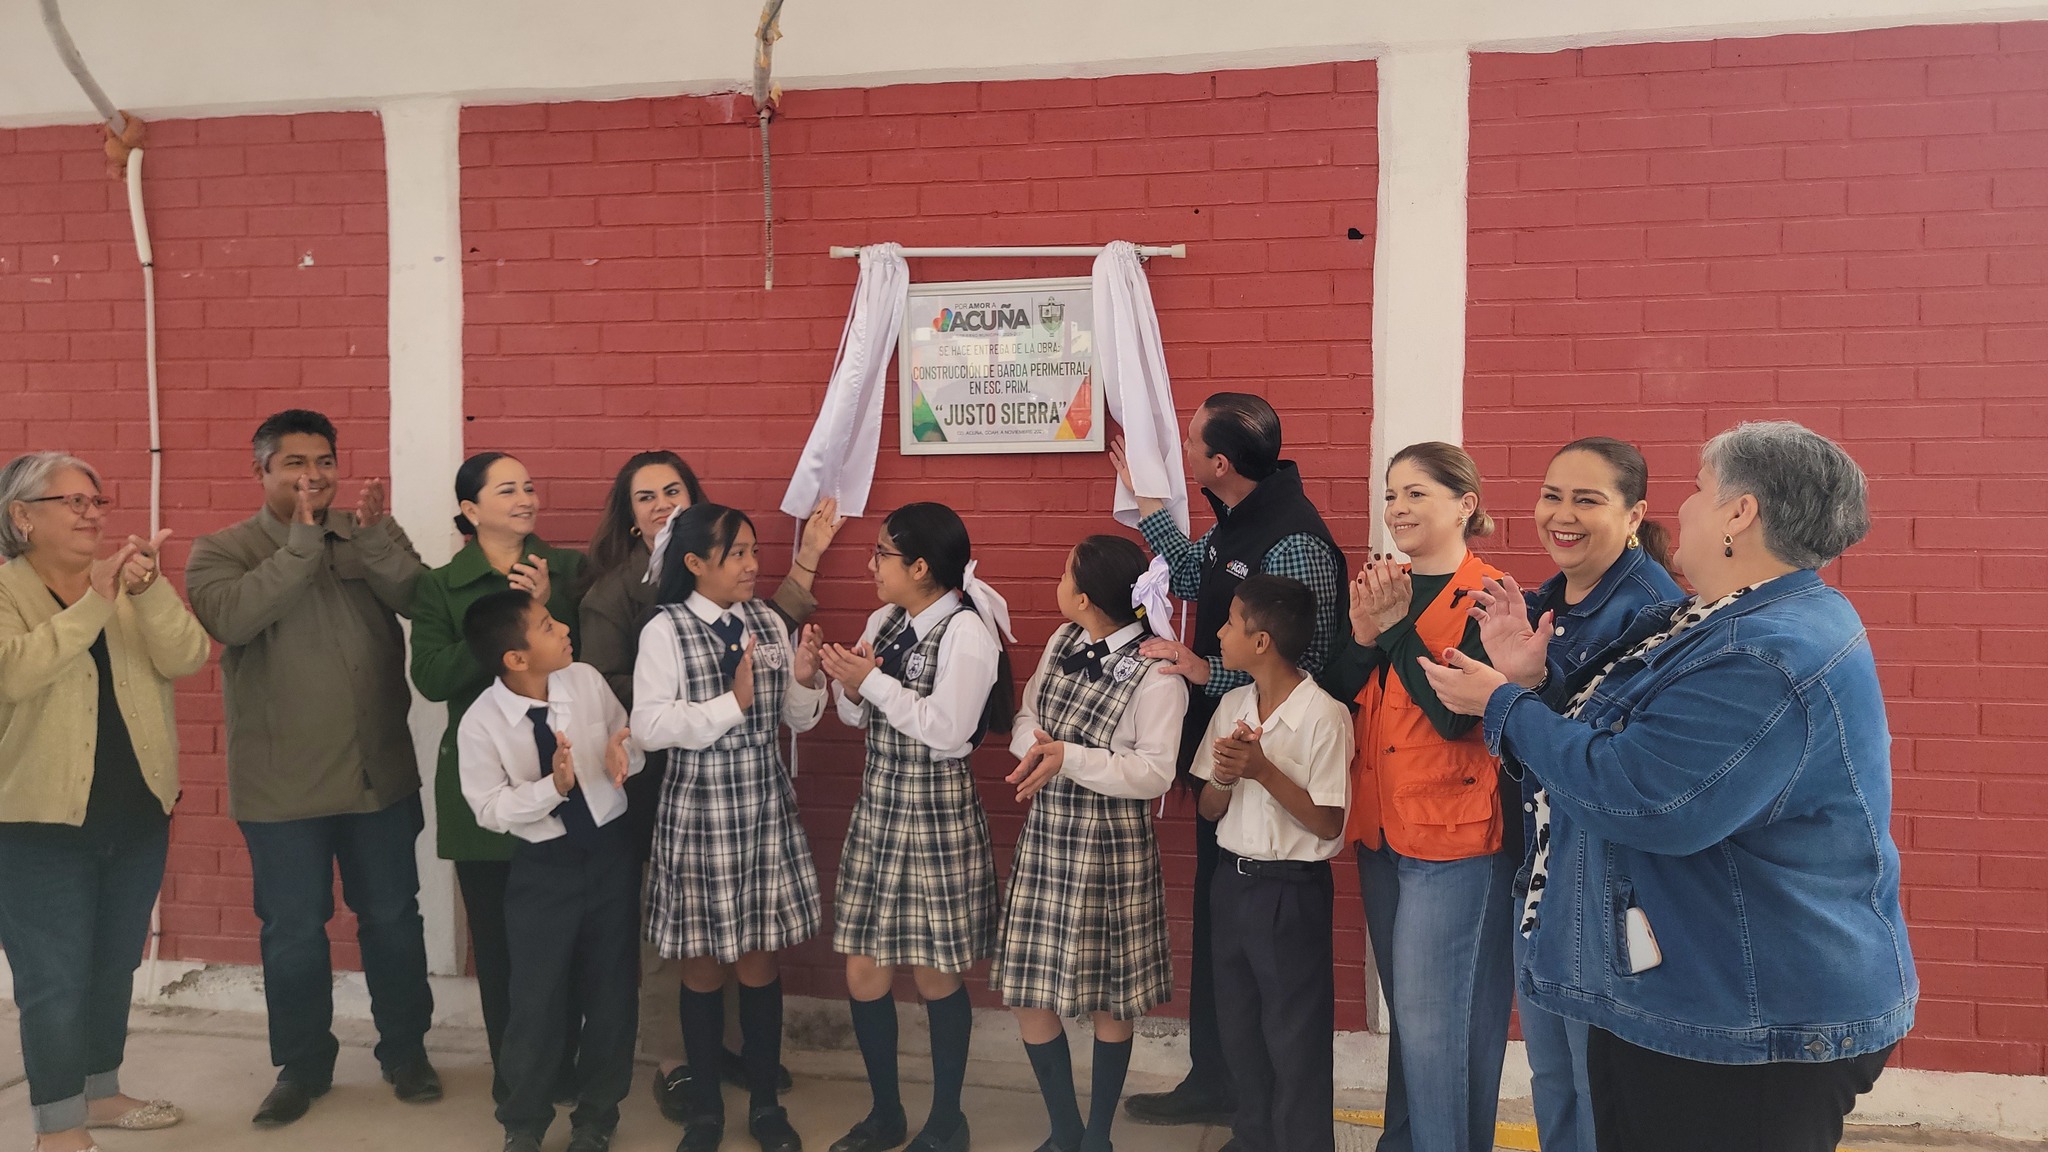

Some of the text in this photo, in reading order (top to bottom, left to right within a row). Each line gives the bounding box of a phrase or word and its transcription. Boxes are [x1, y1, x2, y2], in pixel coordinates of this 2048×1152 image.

[950, 303, 1031, 331] ACUÑA
[939, 345, 949, 356] SE
[951, 344, 971, 356] HACE
[974, 343, 1009, 356] ENTREGA
[1012, 343, 1022, 354] DE
[1025, 343, 1035, 354] LA
[913, 361, 1088, 380] CONSTRUCCIÓN DE BARDA PERIMETRAL
[969, 380, 1031, 395] EN ESC. PRIM.
